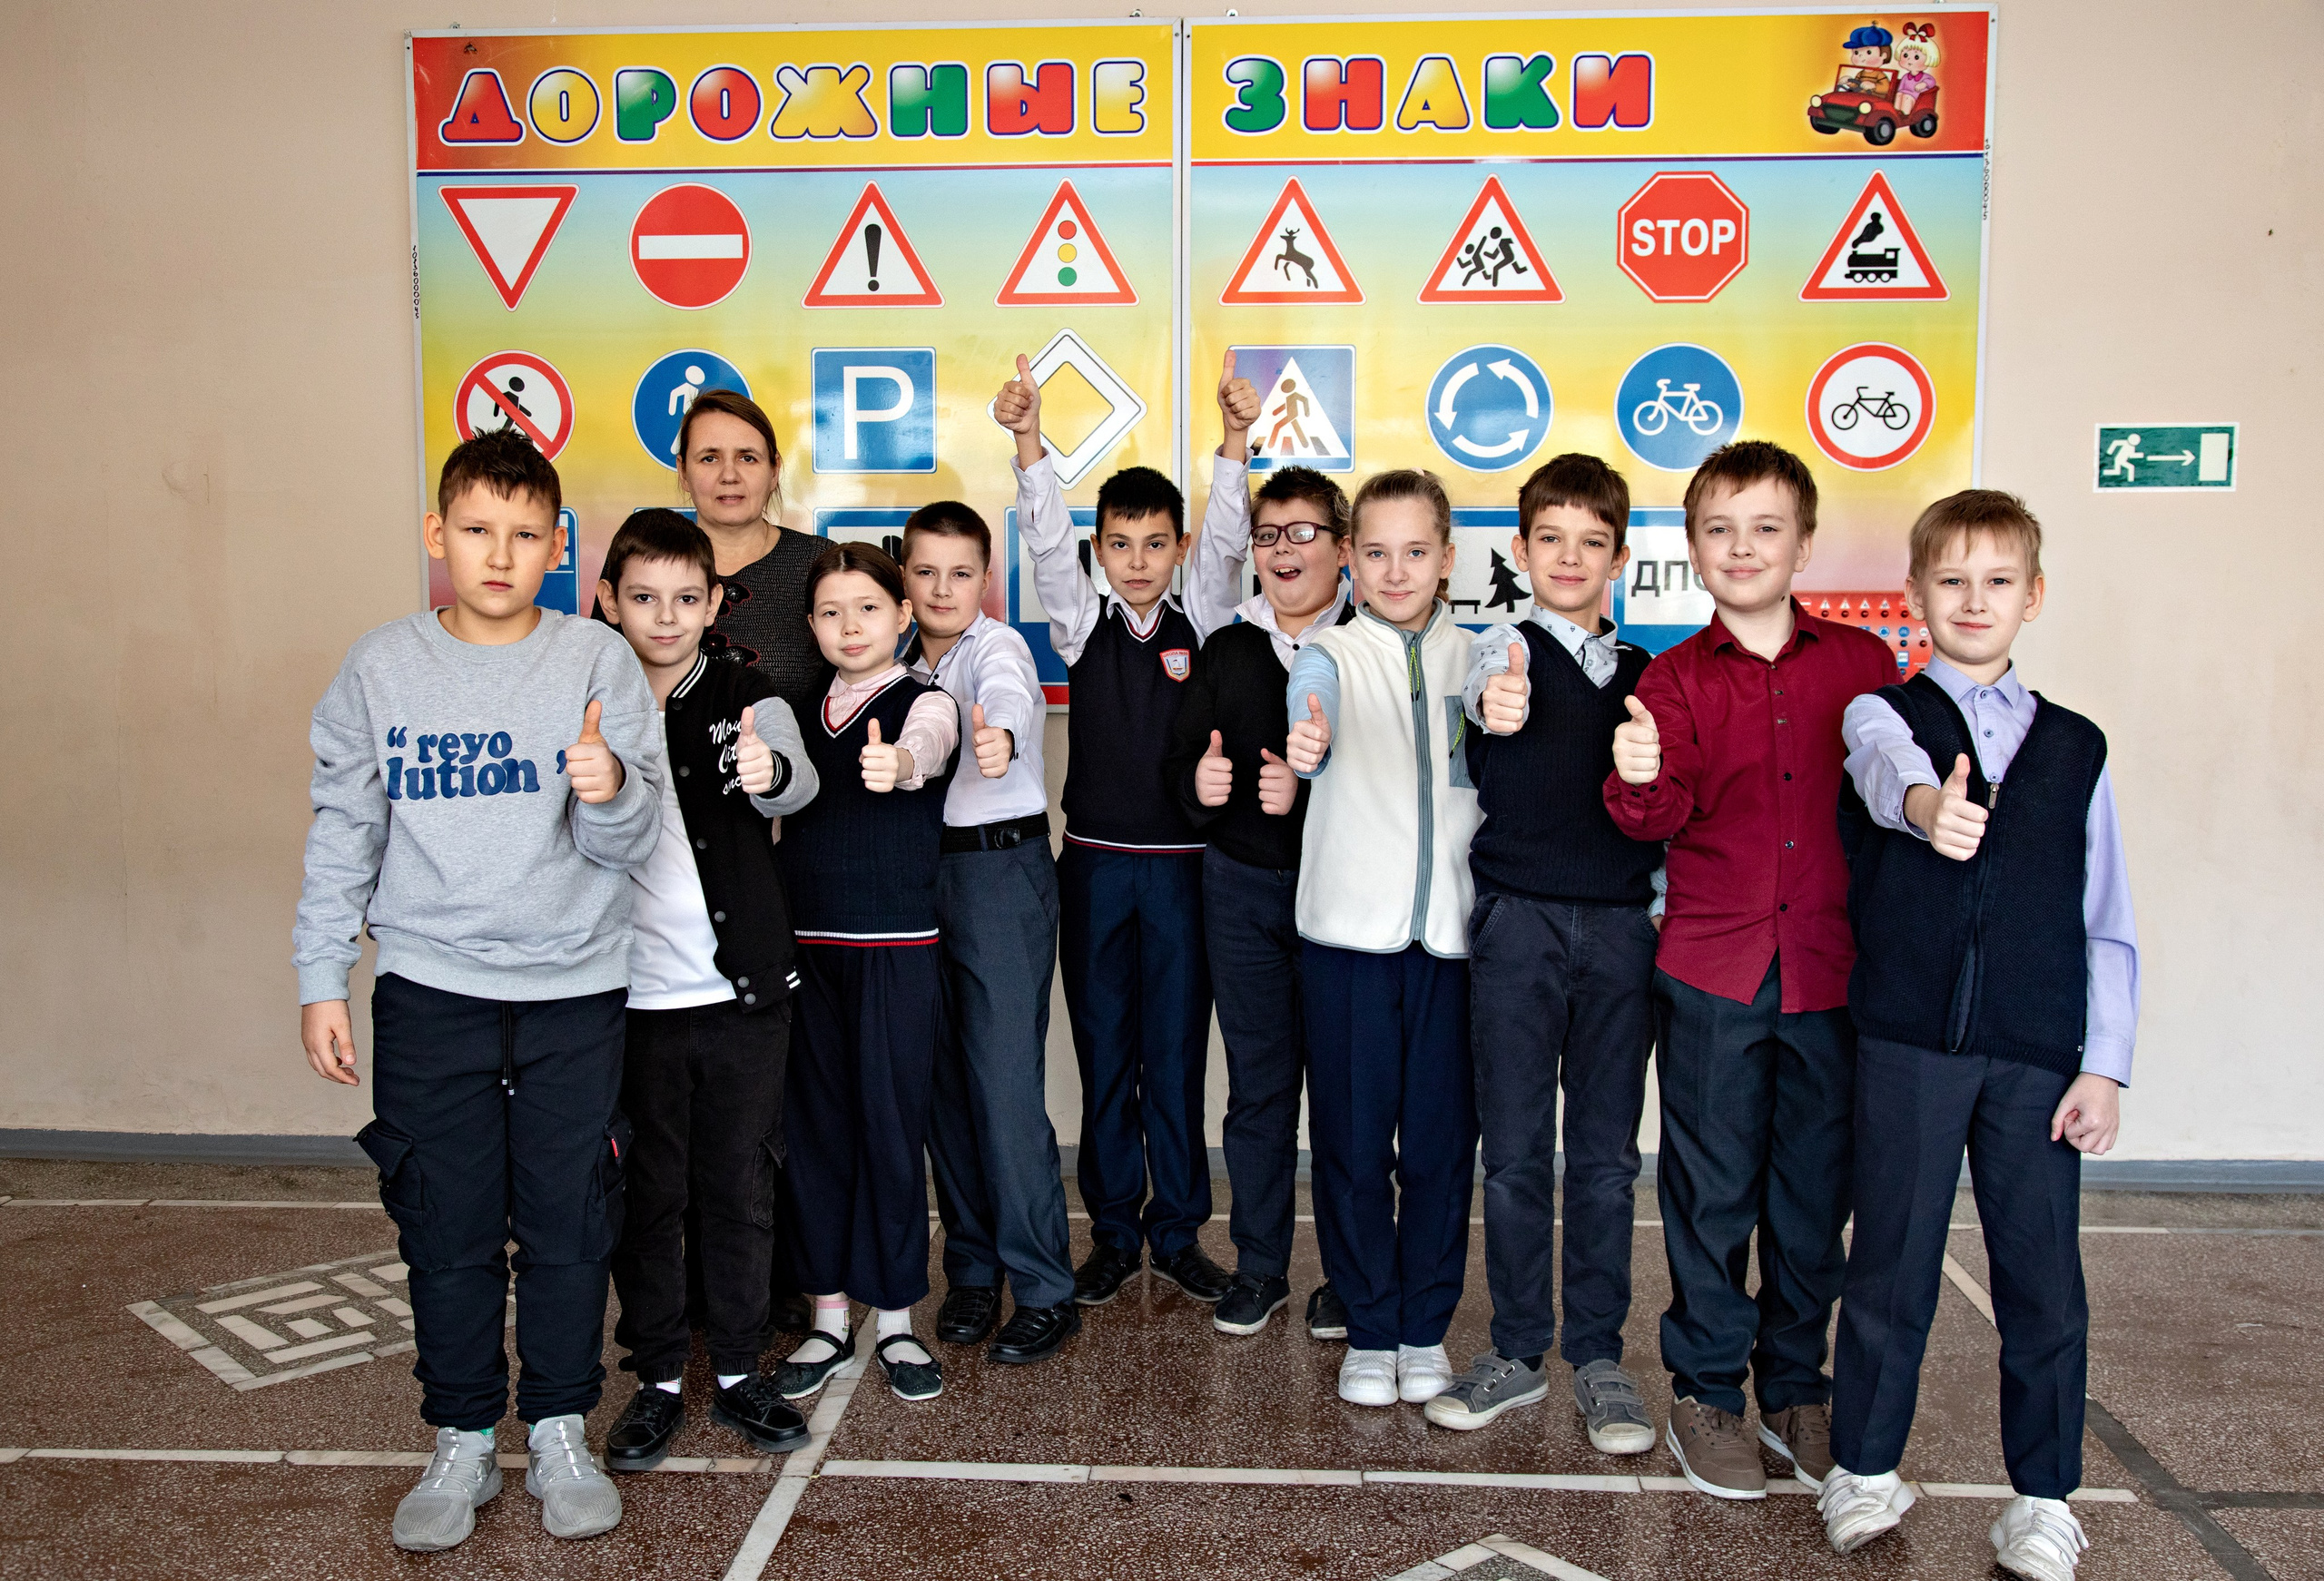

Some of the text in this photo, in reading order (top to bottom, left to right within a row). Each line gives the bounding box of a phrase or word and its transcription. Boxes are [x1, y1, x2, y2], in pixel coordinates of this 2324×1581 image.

[438, 51, 1655, 146] ДОРОЖНЫЕ ЗНАКИ
[1631, 218, 1737, 257] STOP
[387, 756, 540, 800] lution
